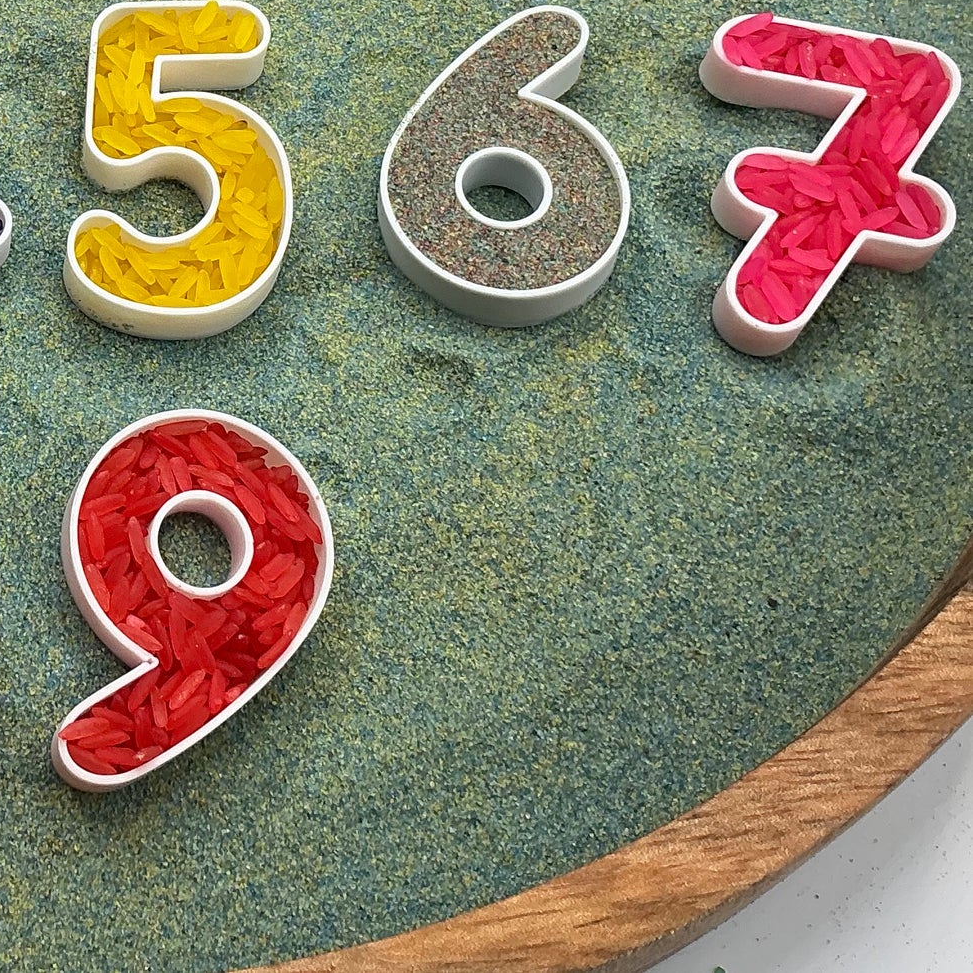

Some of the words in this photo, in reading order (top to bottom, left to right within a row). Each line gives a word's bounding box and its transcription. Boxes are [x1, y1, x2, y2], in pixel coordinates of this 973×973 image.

[65, 0, 293, 337] 5
[379, 6, 631, 325] 6
[699, 11, 962, 354] 7
[53, 408, 334, 790] 9
